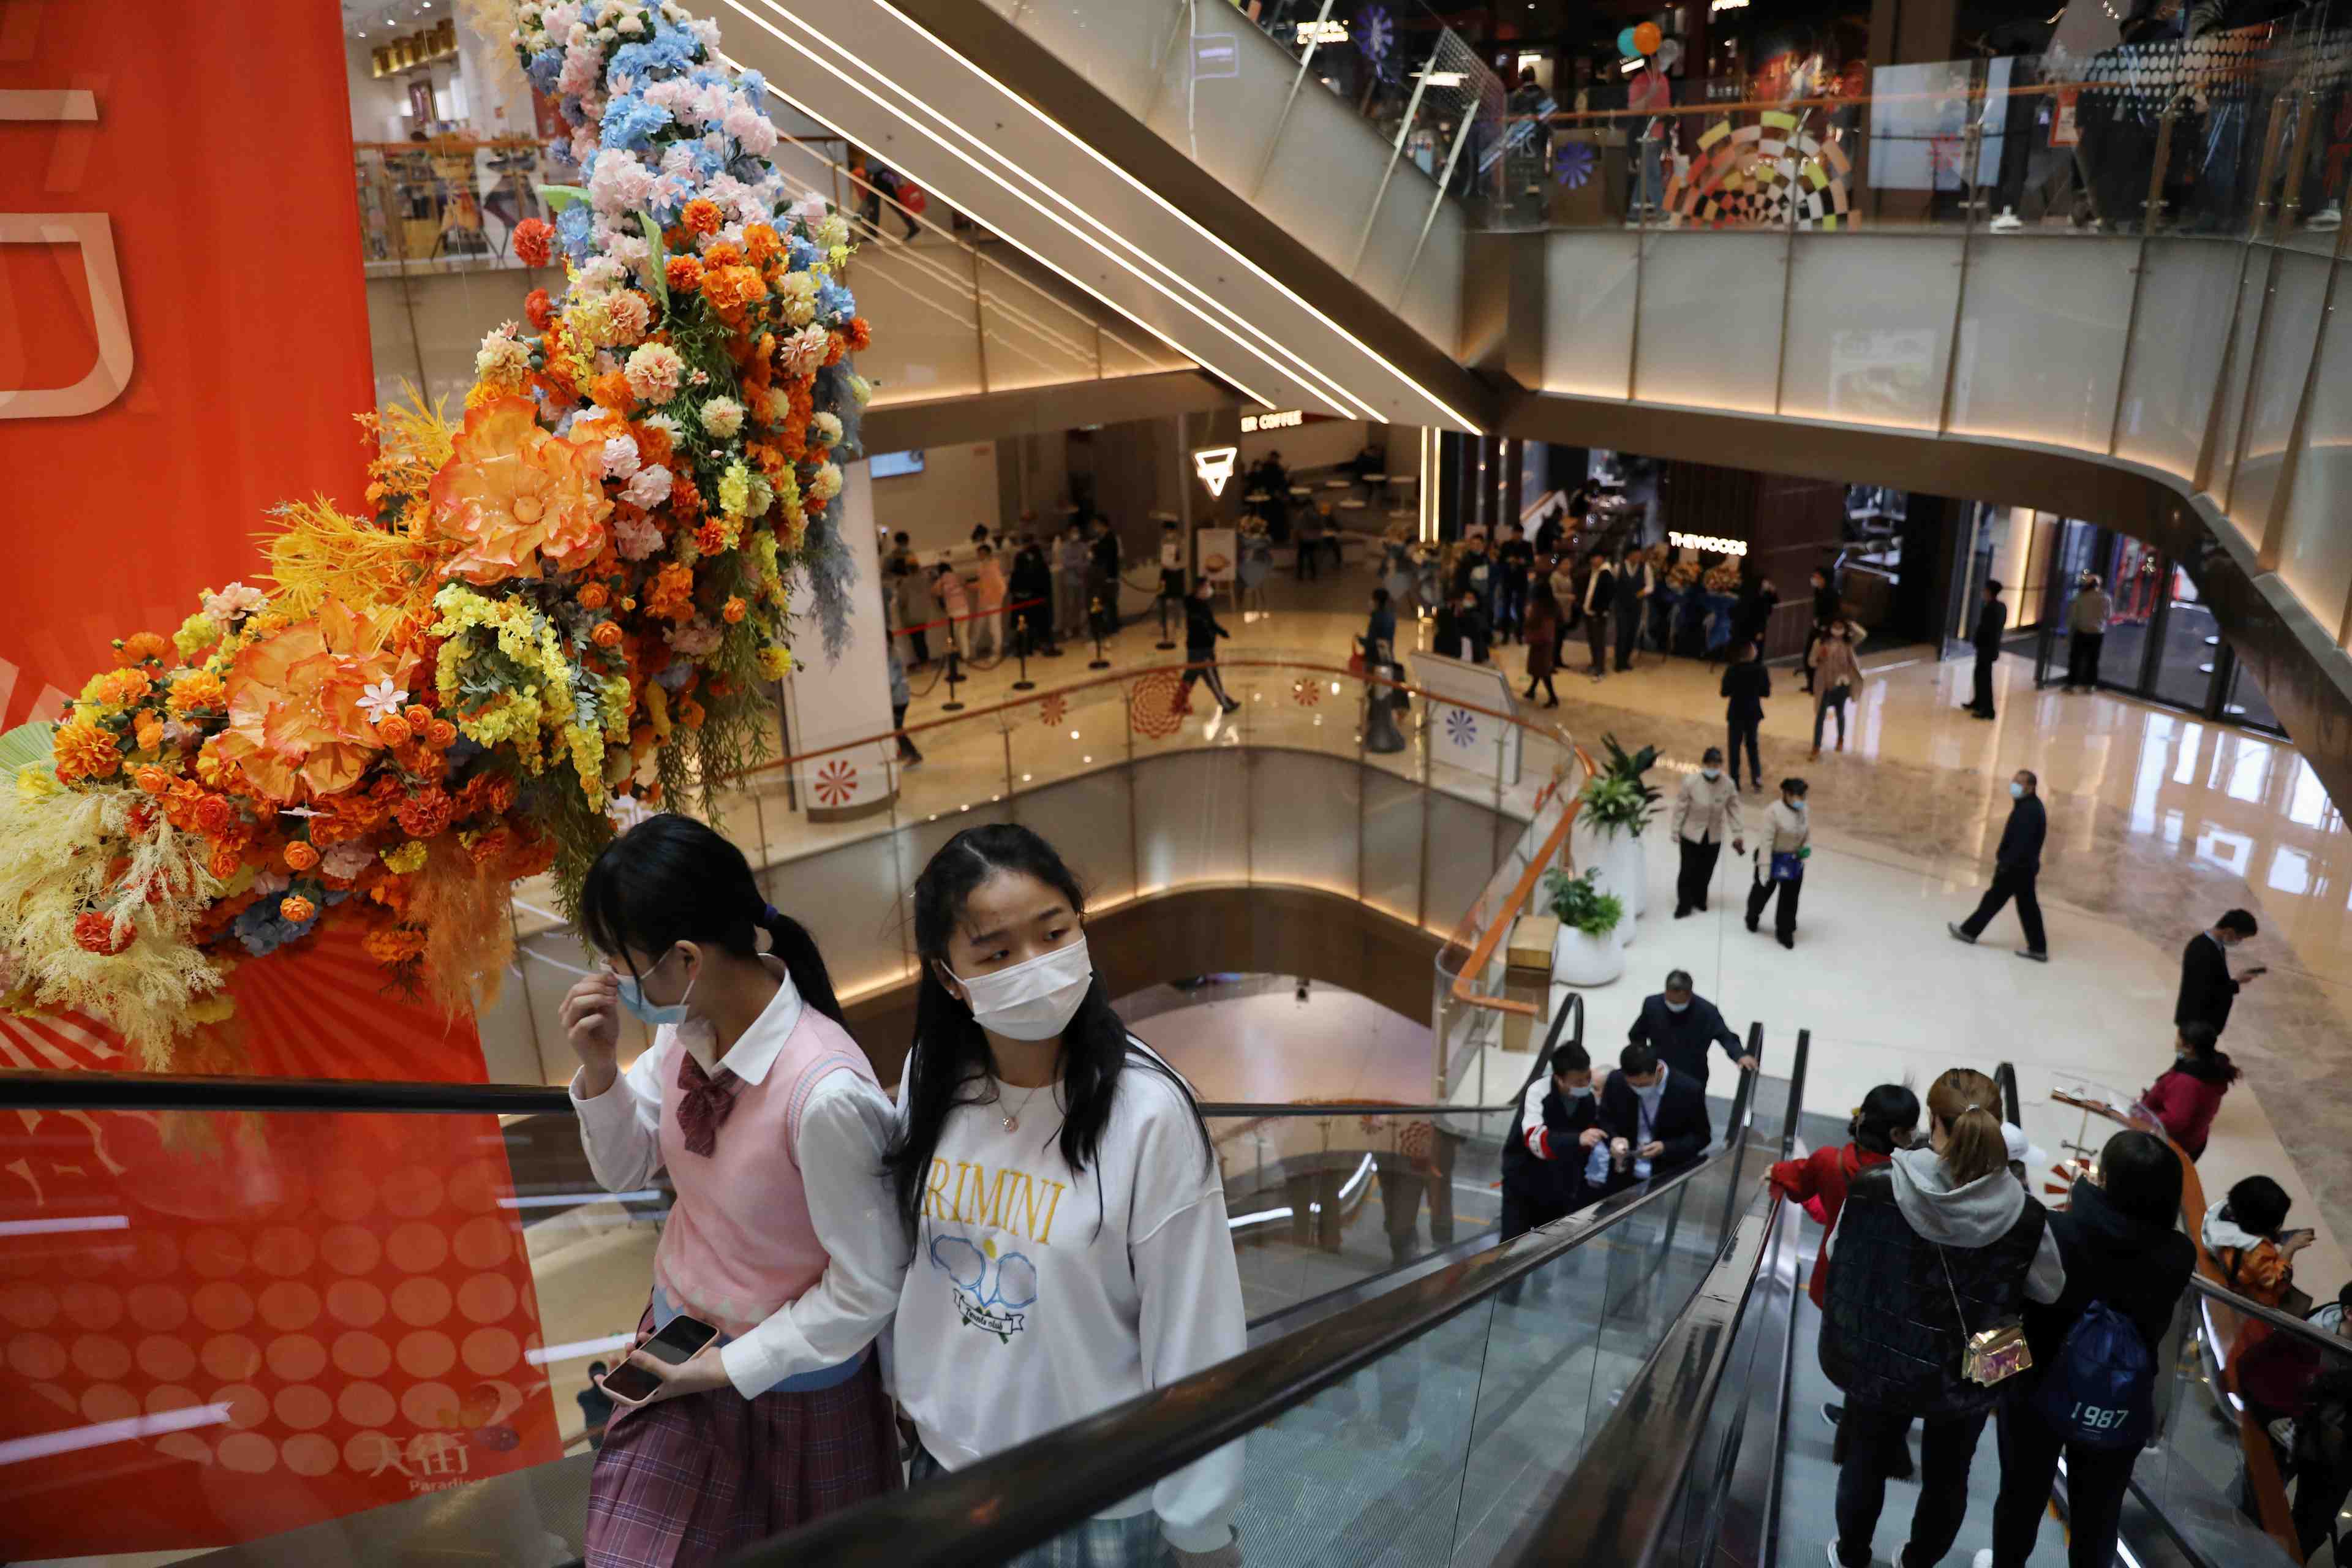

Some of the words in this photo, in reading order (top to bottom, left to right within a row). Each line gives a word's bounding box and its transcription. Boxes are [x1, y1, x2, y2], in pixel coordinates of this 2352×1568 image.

[1259, 410, 1302, 429] COFFEE
[921, 1156, 1066, 1245] RIMINI
[2071, 1402, 2129, 1429] 1987
